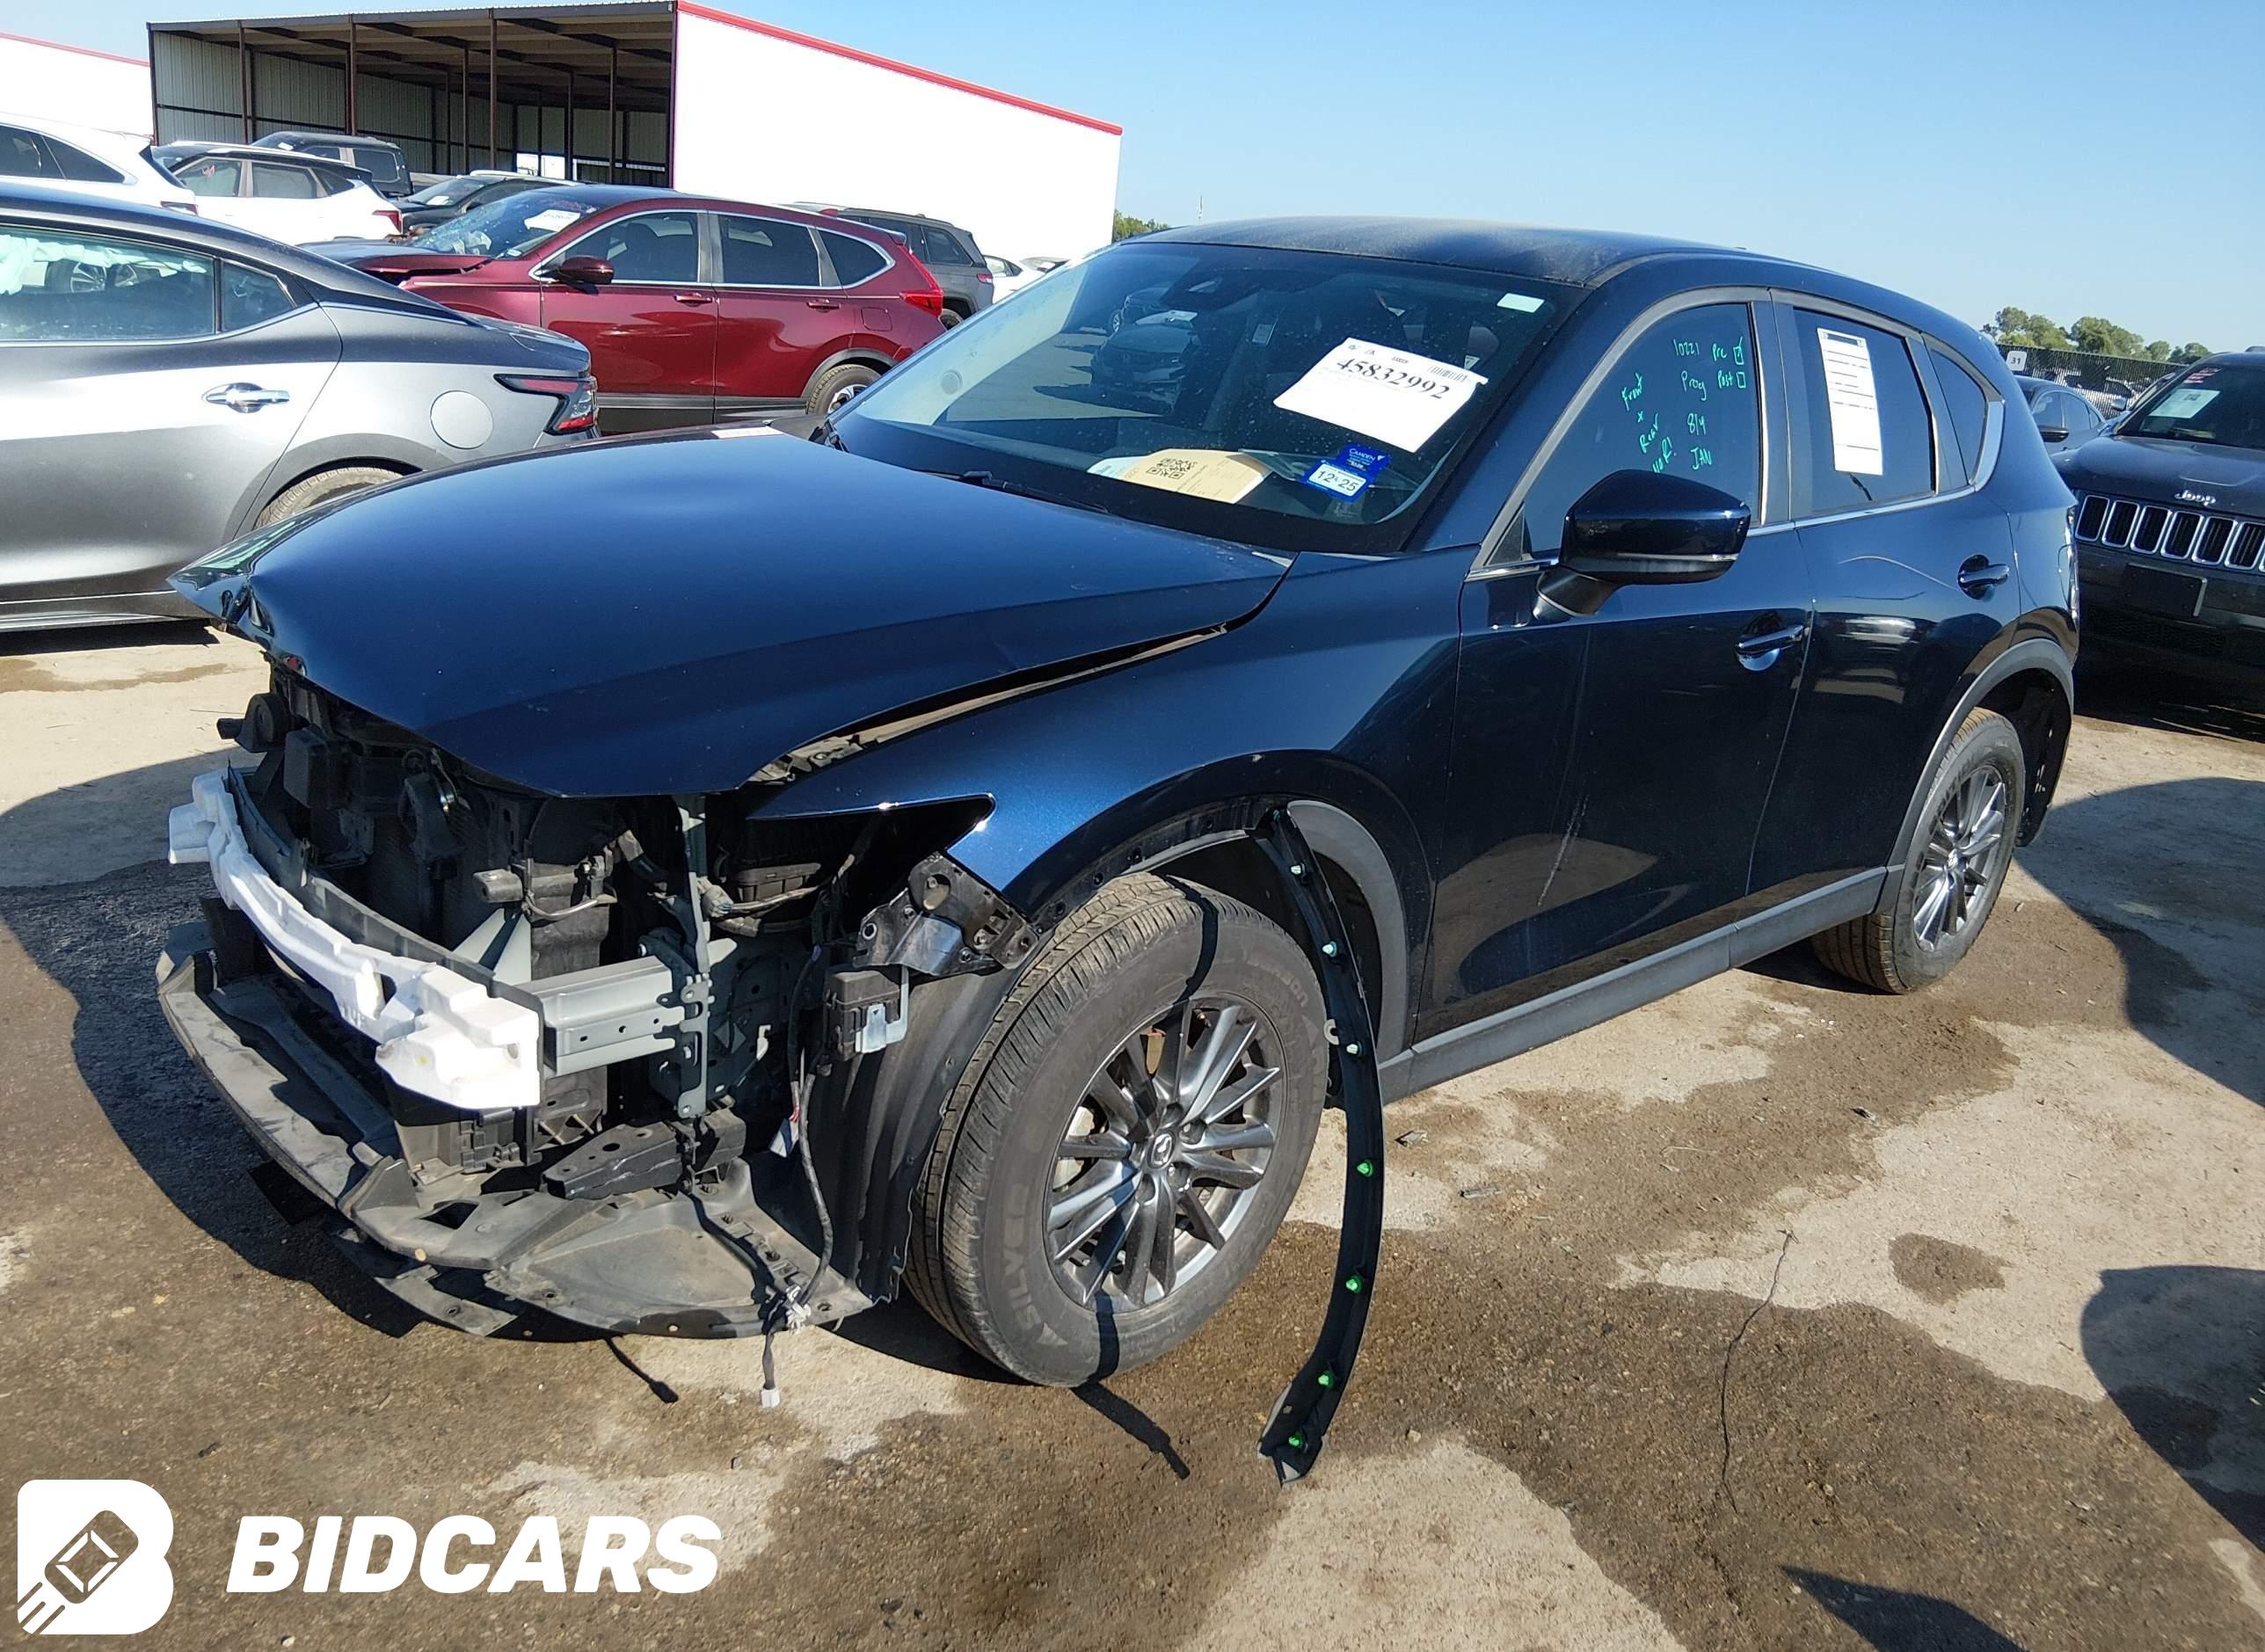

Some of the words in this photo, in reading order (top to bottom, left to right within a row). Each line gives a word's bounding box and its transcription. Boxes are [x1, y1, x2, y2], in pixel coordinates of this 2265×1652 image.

[2010, 356, 2021, 366] 31
[1336, 358, 1450, 399] 45832992
[2174, 489, 2217, 506] Jeep
